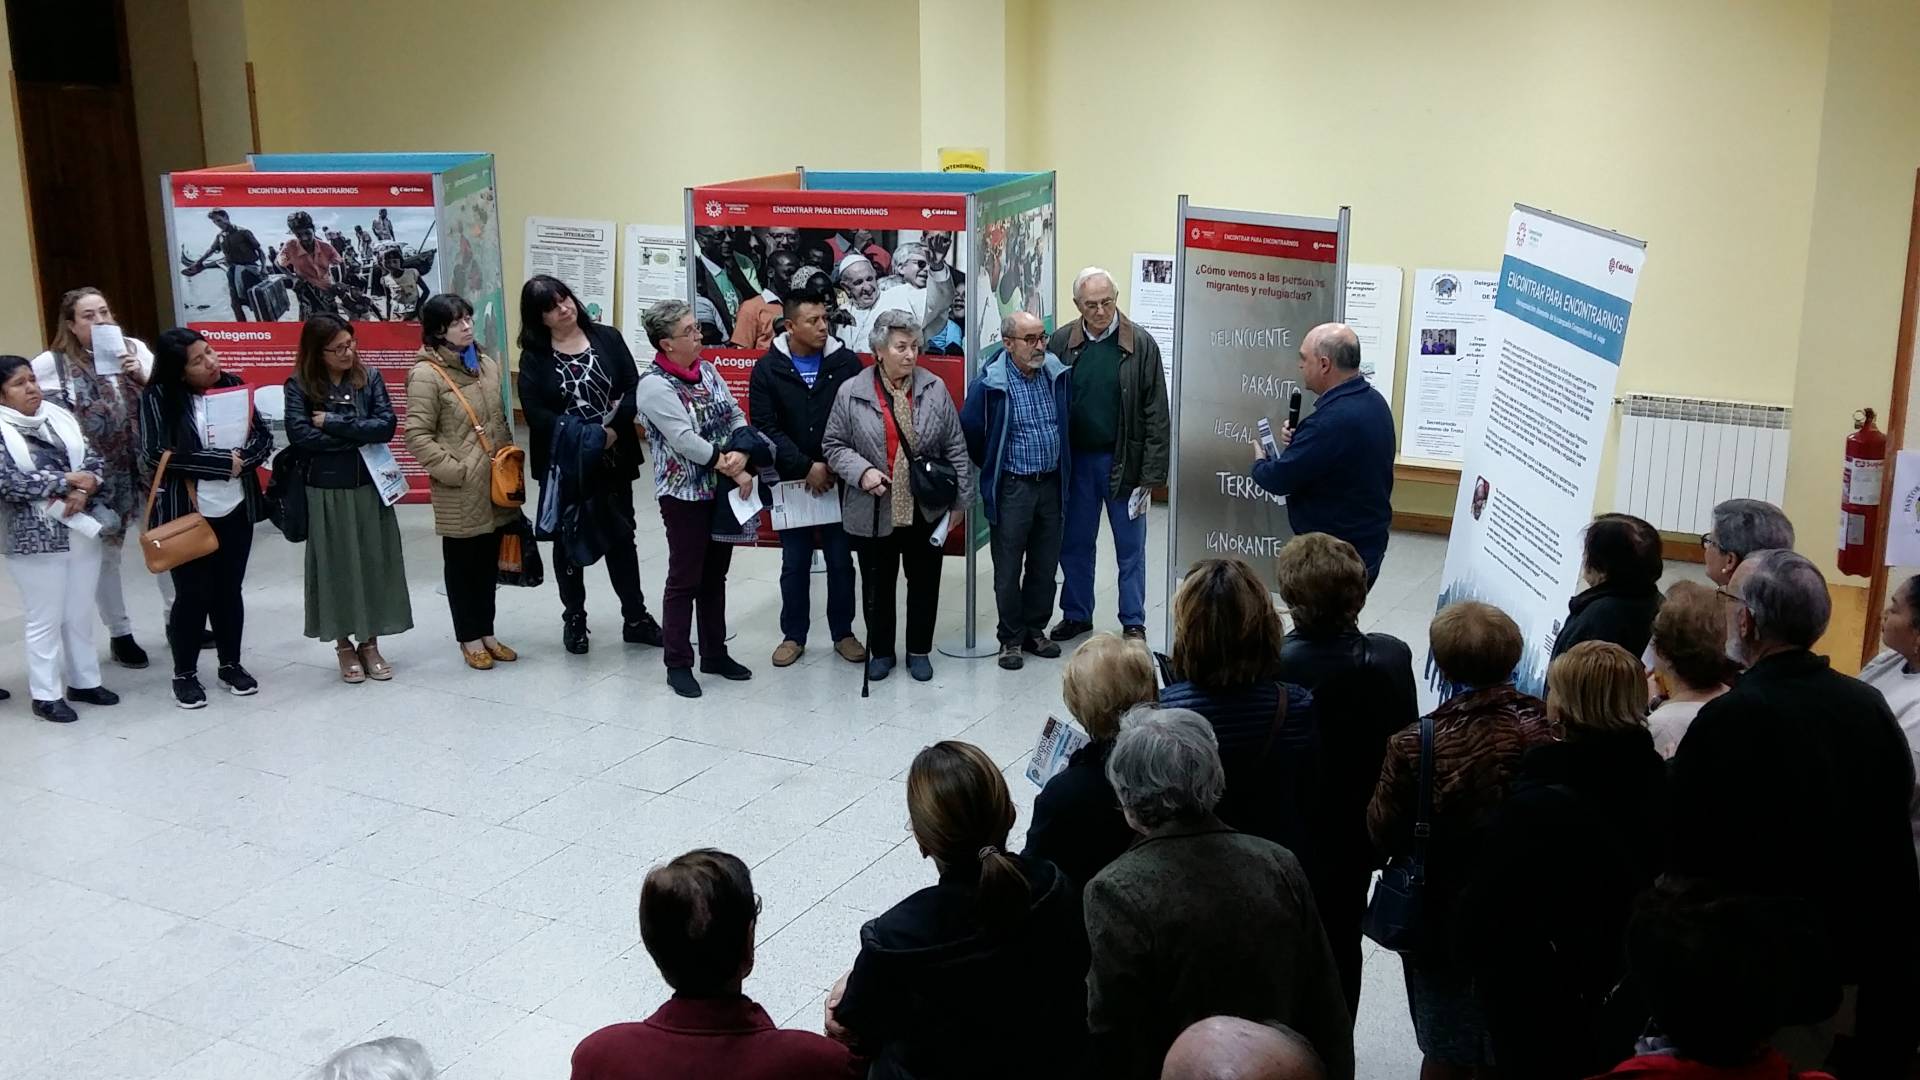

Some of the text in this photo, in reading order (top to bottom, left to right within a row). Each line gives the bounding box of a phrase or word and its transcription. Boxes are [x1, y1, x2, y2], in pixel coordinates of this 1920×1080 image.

[772, 205, 889, 216] ENCONTRAR PARA ENCONTRARNOS
[1224, 233, 1250, 242] ENCONTRAR
[1250, 235, 1262, 243] PARA
[1263, 237, 1299, 248] ENCONTRARNOS
[1195, 264, 1326, 288] ¿Cómo vemos a las personas
[1614, 260, 1634, 275] Cáritas
[1206, 280, 1312, 302] migrantes y refugiadas?
[1507, 271, 1546, 303] ENCONTRAR
[1545, 286, 1564, 309] PARA
[1563, 294, 1625, 335] ENCONTRARNOS
[200, 329, 271, 342] Protegemos
[1210, 327, 1292, 349] DELINCUENTE
[1213, 416, 1254, 445] ILEGAL
[1206, 530, 1282, 558] IGNORANTE
[1045, 721, 1063, 754] inmigra
[1031, 736, 1049, 766] Burgos
